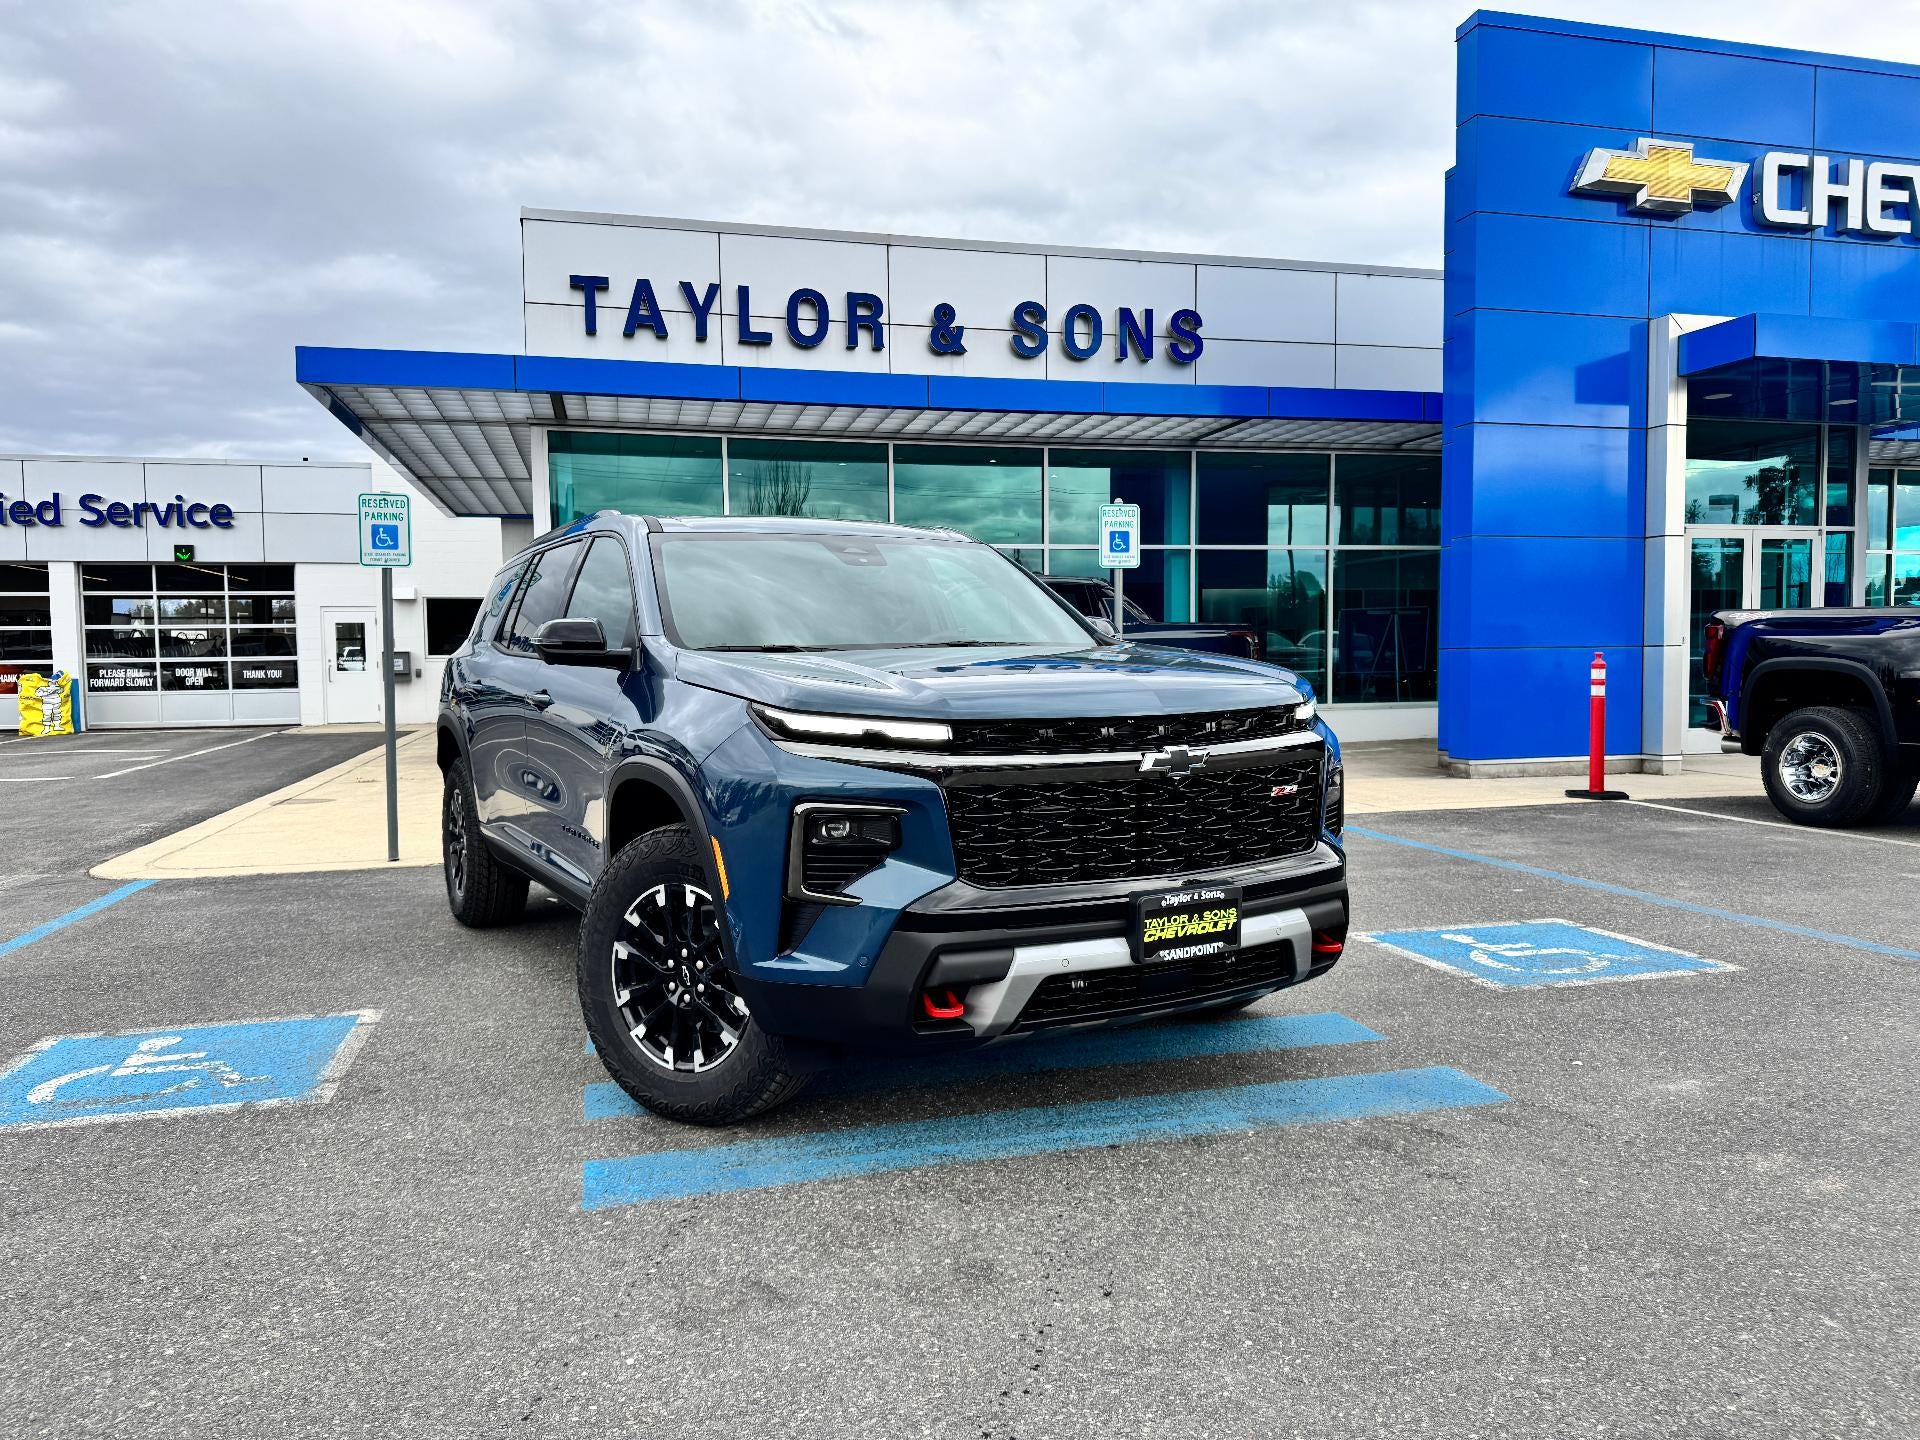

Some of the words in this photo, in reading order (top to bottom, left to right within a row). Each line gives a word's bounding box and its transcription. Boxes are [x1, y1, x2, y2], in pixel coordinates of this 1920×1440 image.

[1755, 152, 1920, 234] CHE
[569, 274, 886, 351] TAYLOR
[928, 303, 968, 356] &
[1009, 300, 1204, 363] SONS
[361, 498, 406, 509] RESERVED
[78, 493, 234, 528] Service
[1102, 509, 1136, 518] RESERVED
[364, 511, 404, 521] PARKING
[1104, 520, 1134, 528] PARKING
[99, 669, 126, 678] PLEASE
[127, 669, 143, 678] PULL
[175, 668, 195, 677] DOOR
[196, 668, 212, 678] WILL
[243, 670, 265, 679] THANK
[266, 669, 282, 678] YOU!
[90, 678, 124, 687] FORWARD
[125, 678, 153, 687] SLOWLY
[185, 678, 204, 686] OPEN
[1165, 893, 1192, 907] Taylor
[1201, 891, 1221, 900] Sons
[1144, 914, 1189, 930] TAYLOR
[1191, 914, 1200, 924] &
[1203, 907, 1237, 920] SONS
[1144, 919, 1238, 943] CHEVROLET
